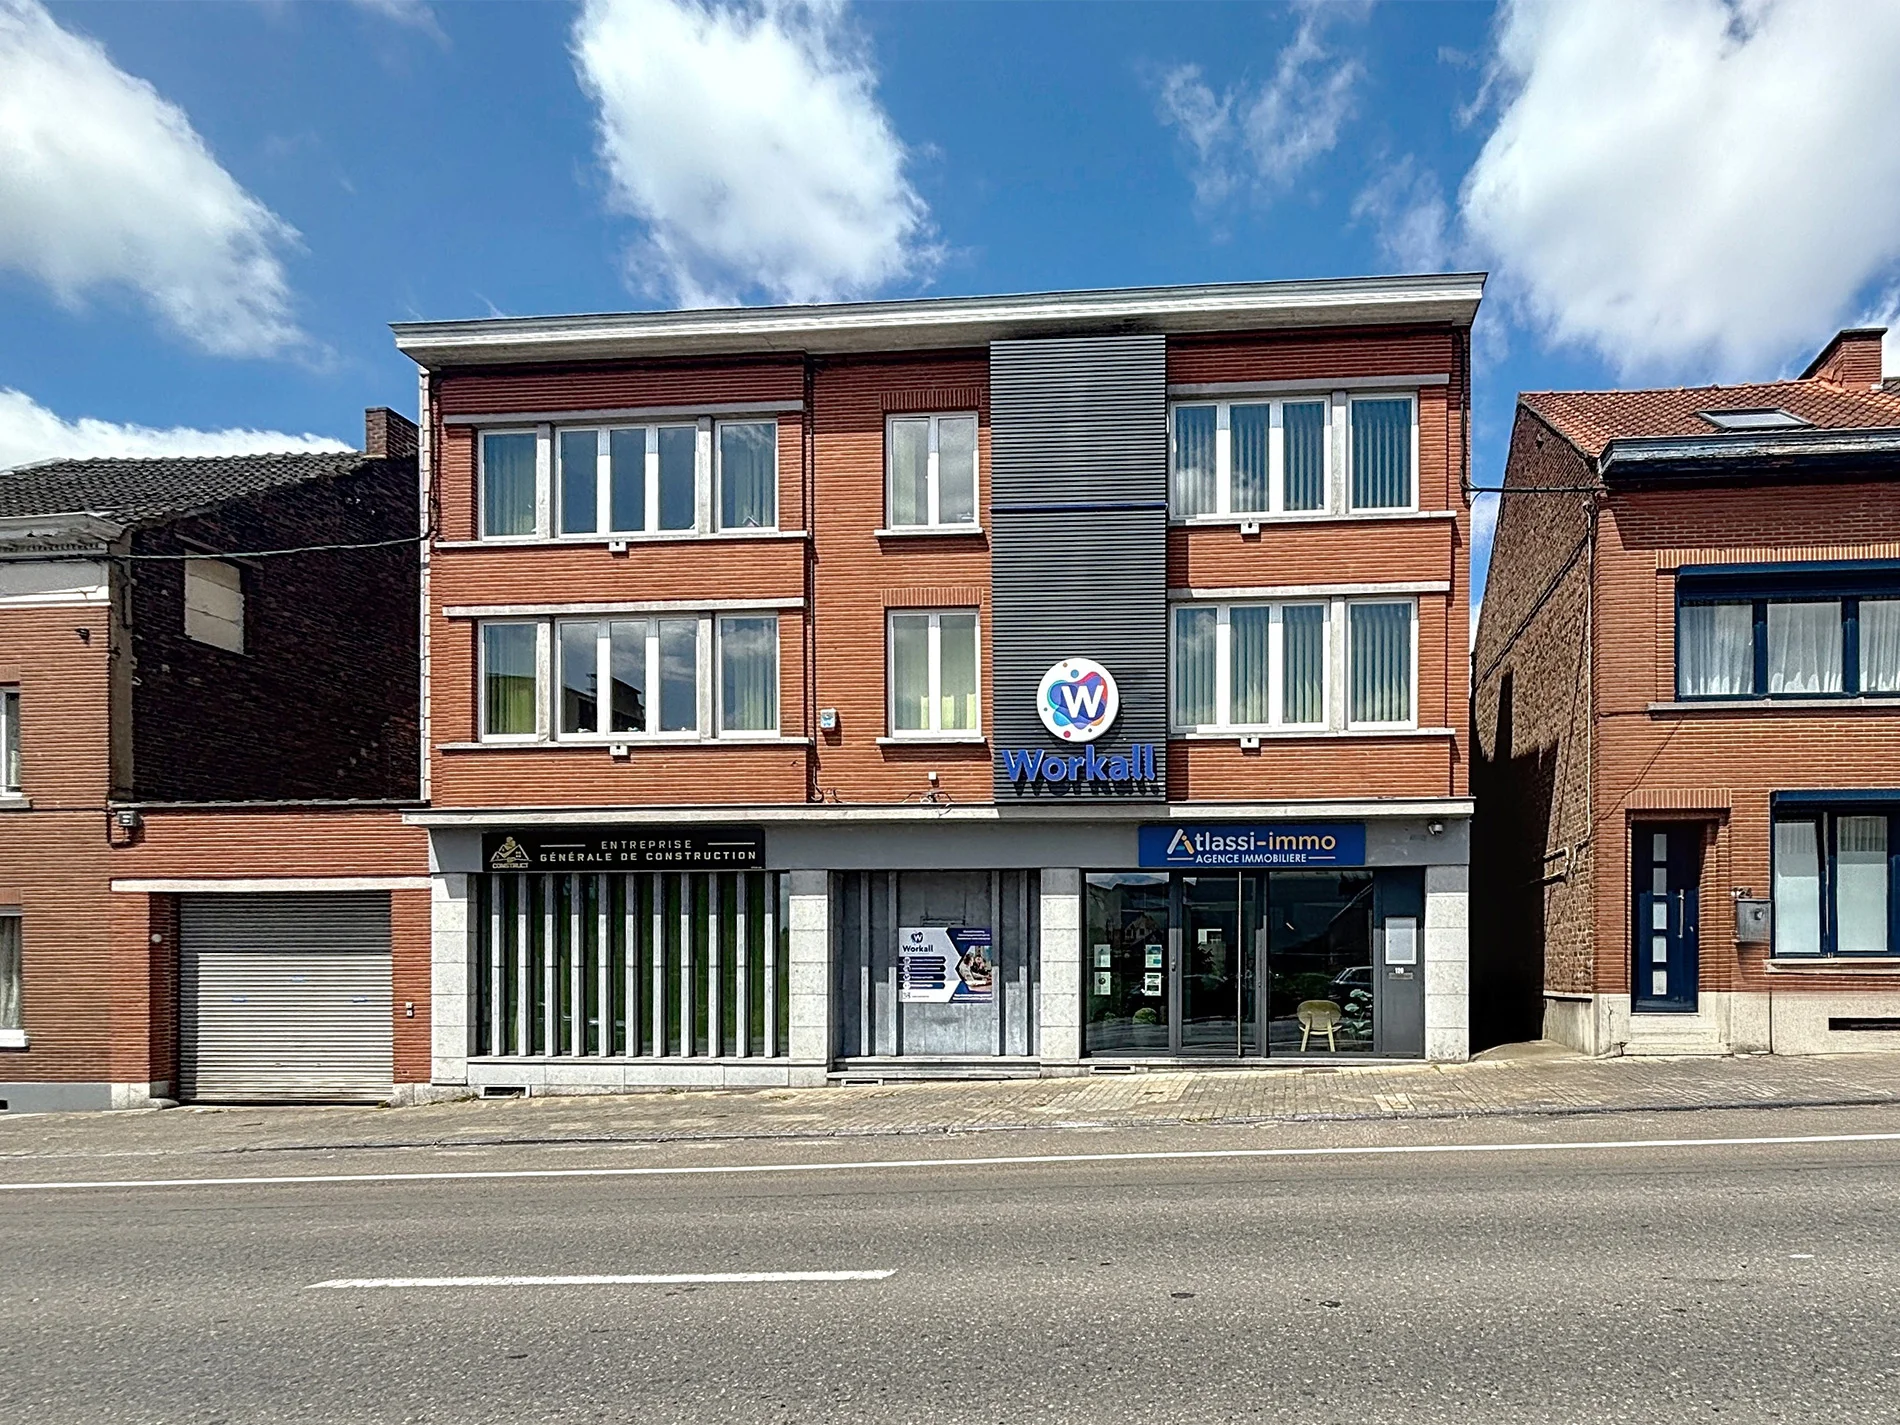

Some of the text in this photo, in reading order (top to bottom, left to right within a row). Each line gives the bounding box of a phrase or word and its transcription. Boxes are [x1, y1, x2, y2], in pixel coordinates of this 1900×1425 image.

[1061, 685, 1105, 719] W
[1002, 744, 1156, 782] Workall
[600, 840, 693, 851] ENTREPRISE
[1166, 828, 1337, 855] Atlassi-immo
[540, 851, 757, 863] GÉNÉRALE DE CONSTRUCTION
[1195, 853, 1308, 864] AGENCE IMMOBILIERE
[902, 944, 934, 953] Workall
